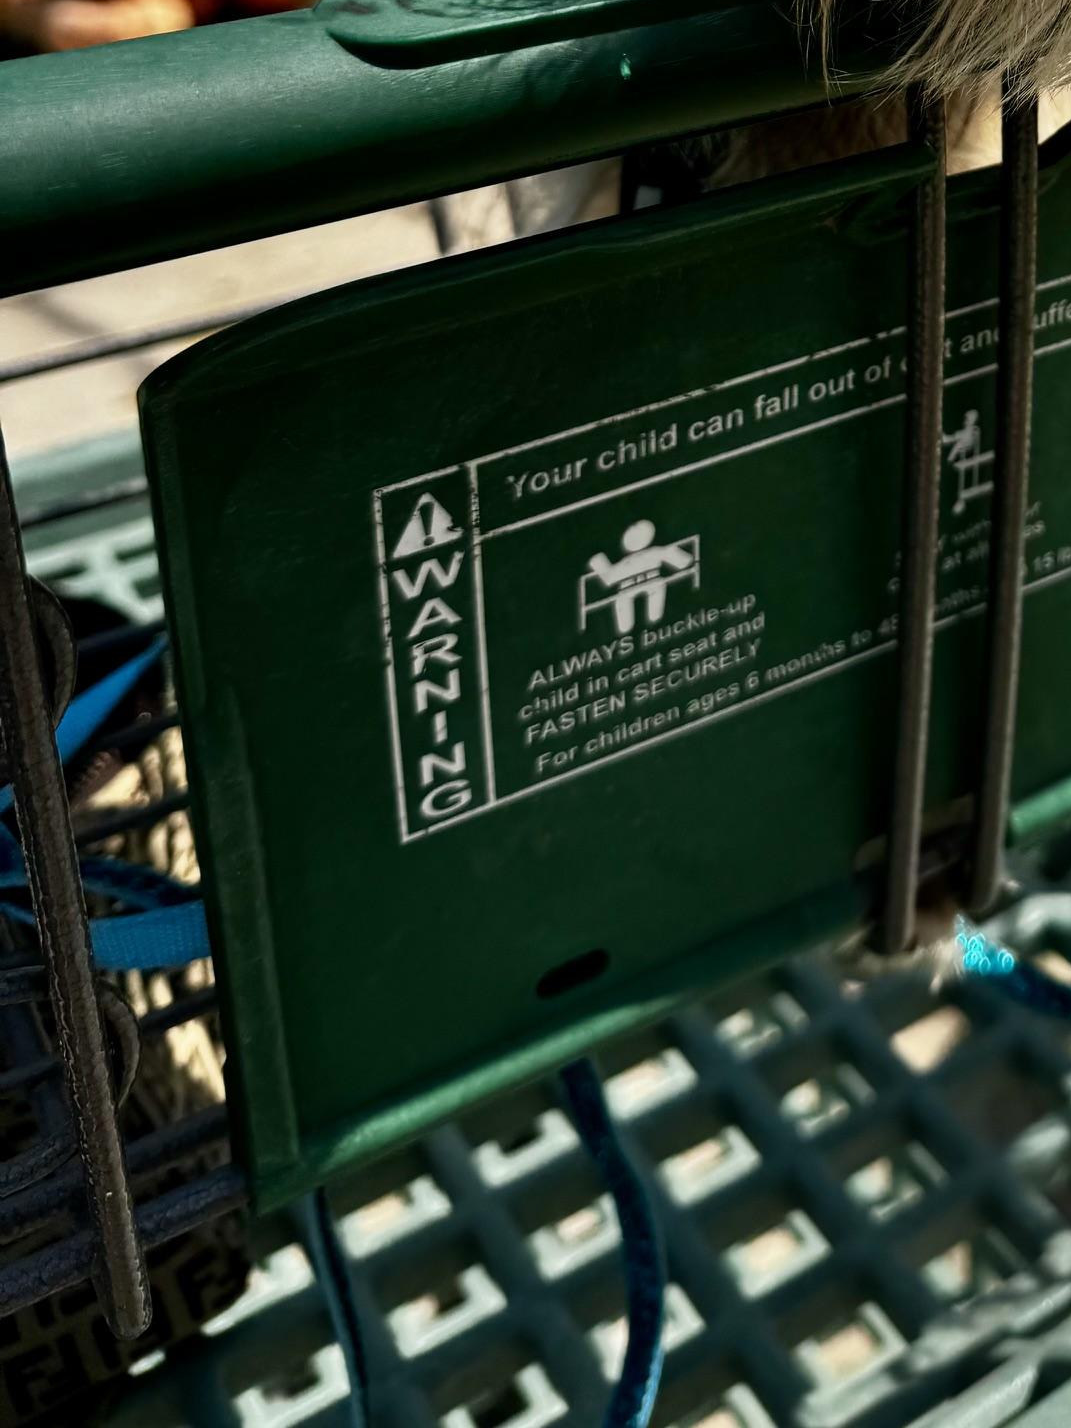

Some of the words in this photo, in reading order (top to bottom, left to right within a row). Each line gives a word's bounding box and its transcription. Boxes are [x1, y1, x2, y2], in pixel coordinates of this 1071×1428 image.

[505, 456, 588, 501] Your
[597, 423, 677, 472] child
[688, 406, 744, 442] can
[754, 384, 798, 421] fall
[808, 368, 855, 403] out
[865, 354, 892, 384] of
[393, 552, 472, 818] WARNING
[519, 681, 580, 721] child
[587, 675, 609, 696] in
[616, 655, 662, 687] cart
[668, 634, 718, 670] seat
[724, 612, 766, 647] and
[524, 692, 624, 745] FASTEN
[634, 638, 761, 701] SECURELY
[528, 635, 634, 692] ALWAYS
[642, 593, 758, 647] buckle-up
[535, 745, 577, 773] For
[583, 706, 680, 754] children
[687, 682, 740, 715] ages
[745, 670, 759, 688] 6
[765, 642, 846, 682] months
